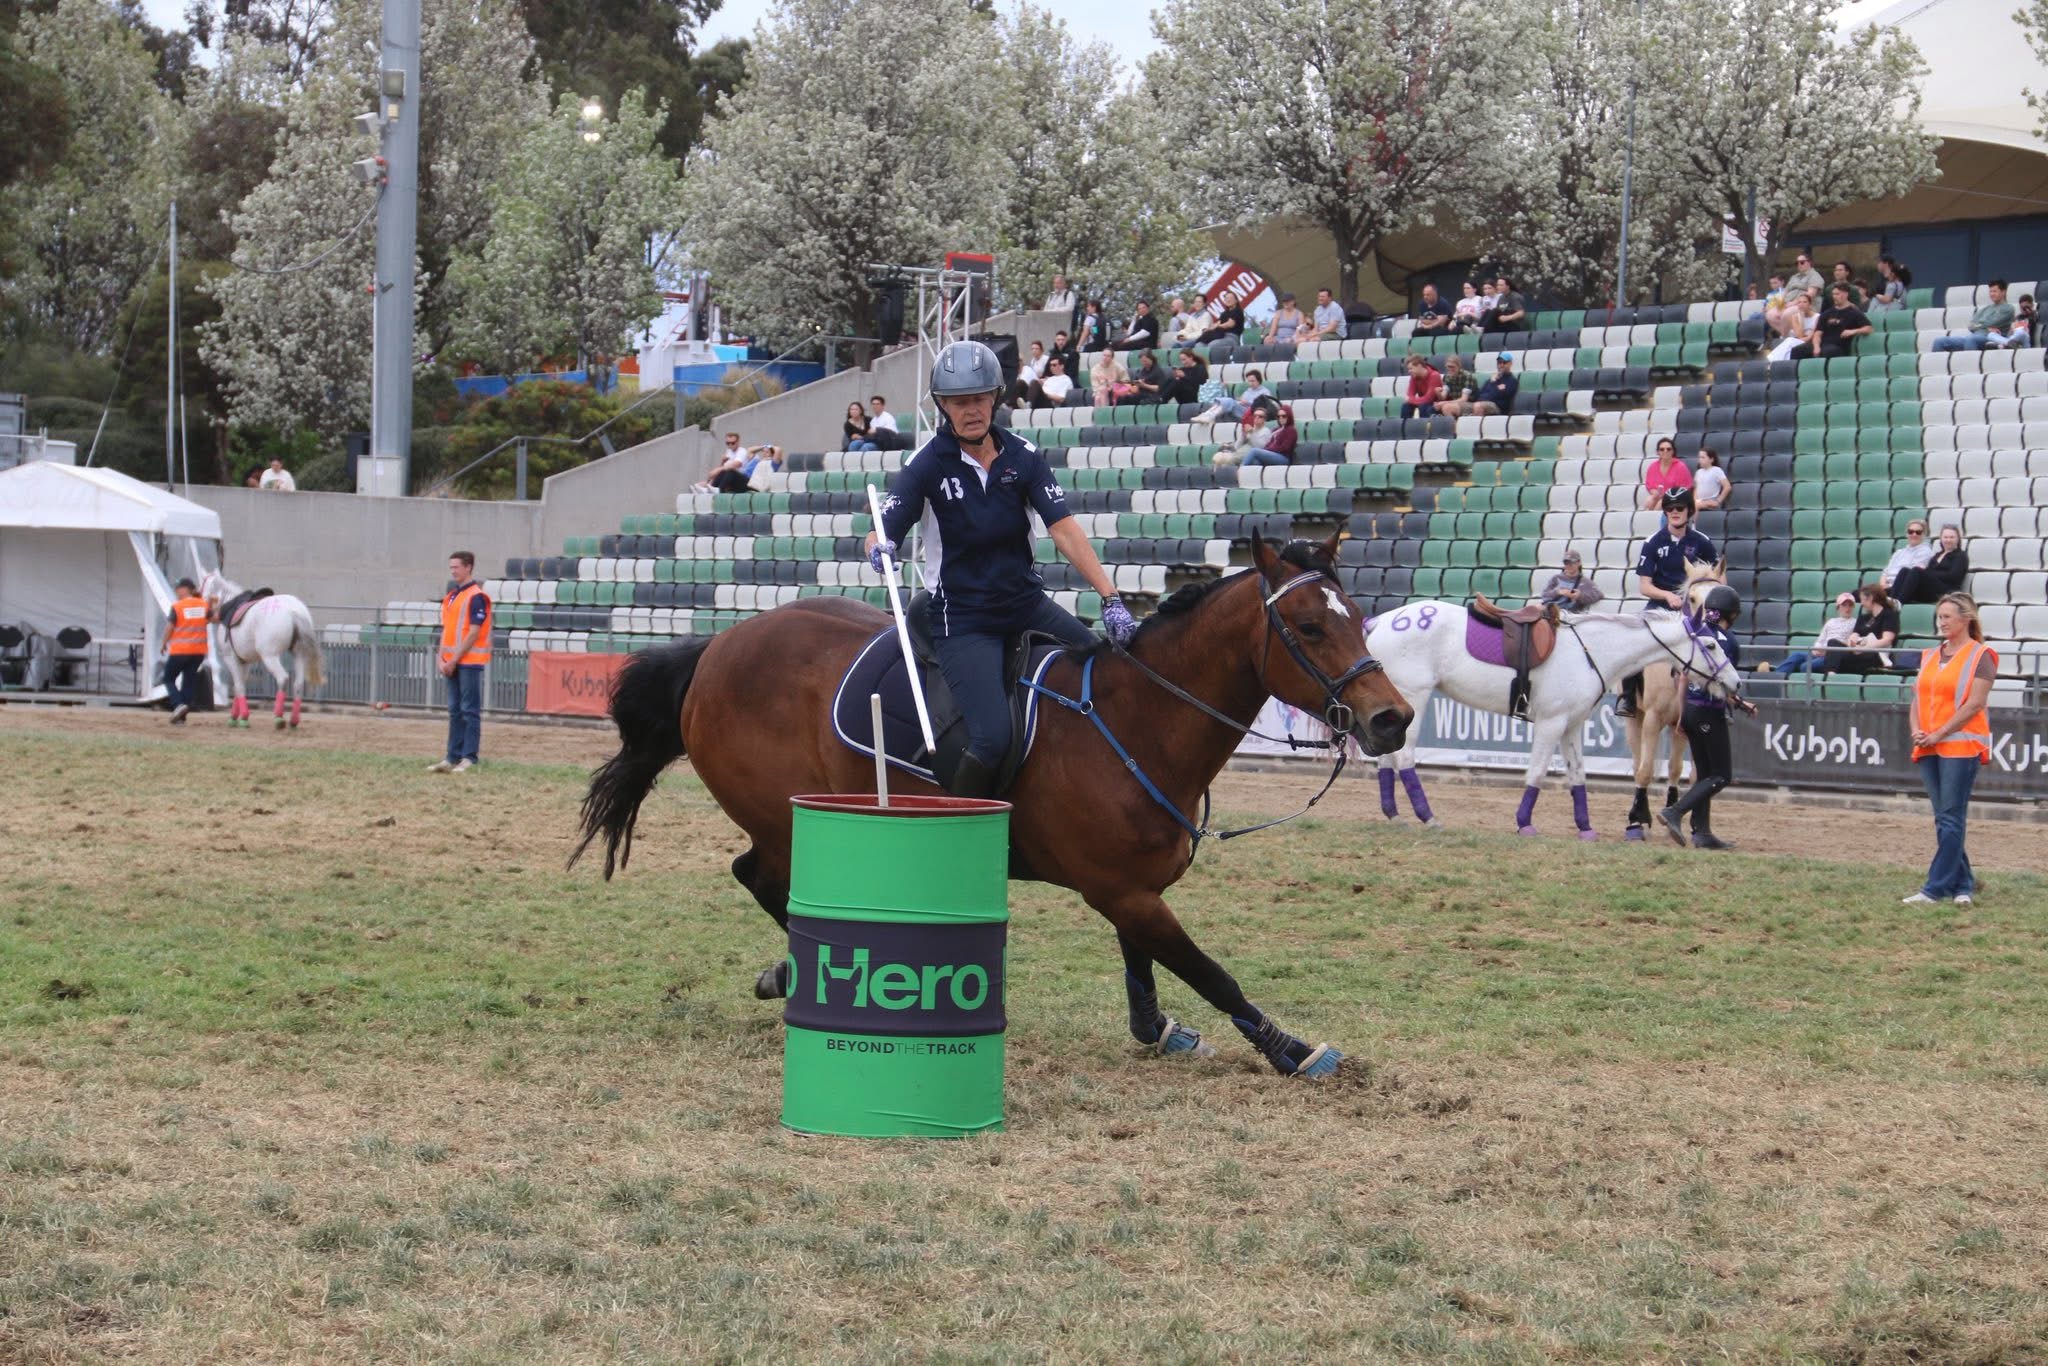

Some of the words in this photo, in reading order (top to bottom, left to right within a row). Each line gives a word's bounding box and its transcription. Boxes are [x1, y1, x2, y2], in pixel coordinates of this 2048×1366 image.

[940, 477, 964, 500] 13
[1657, 546, 1670, 558] 97
[1391, 606, 1437, 632] 68
[1765, 723, 1881, 765] Kubota
[816, 944, 989, 1010] Hero
